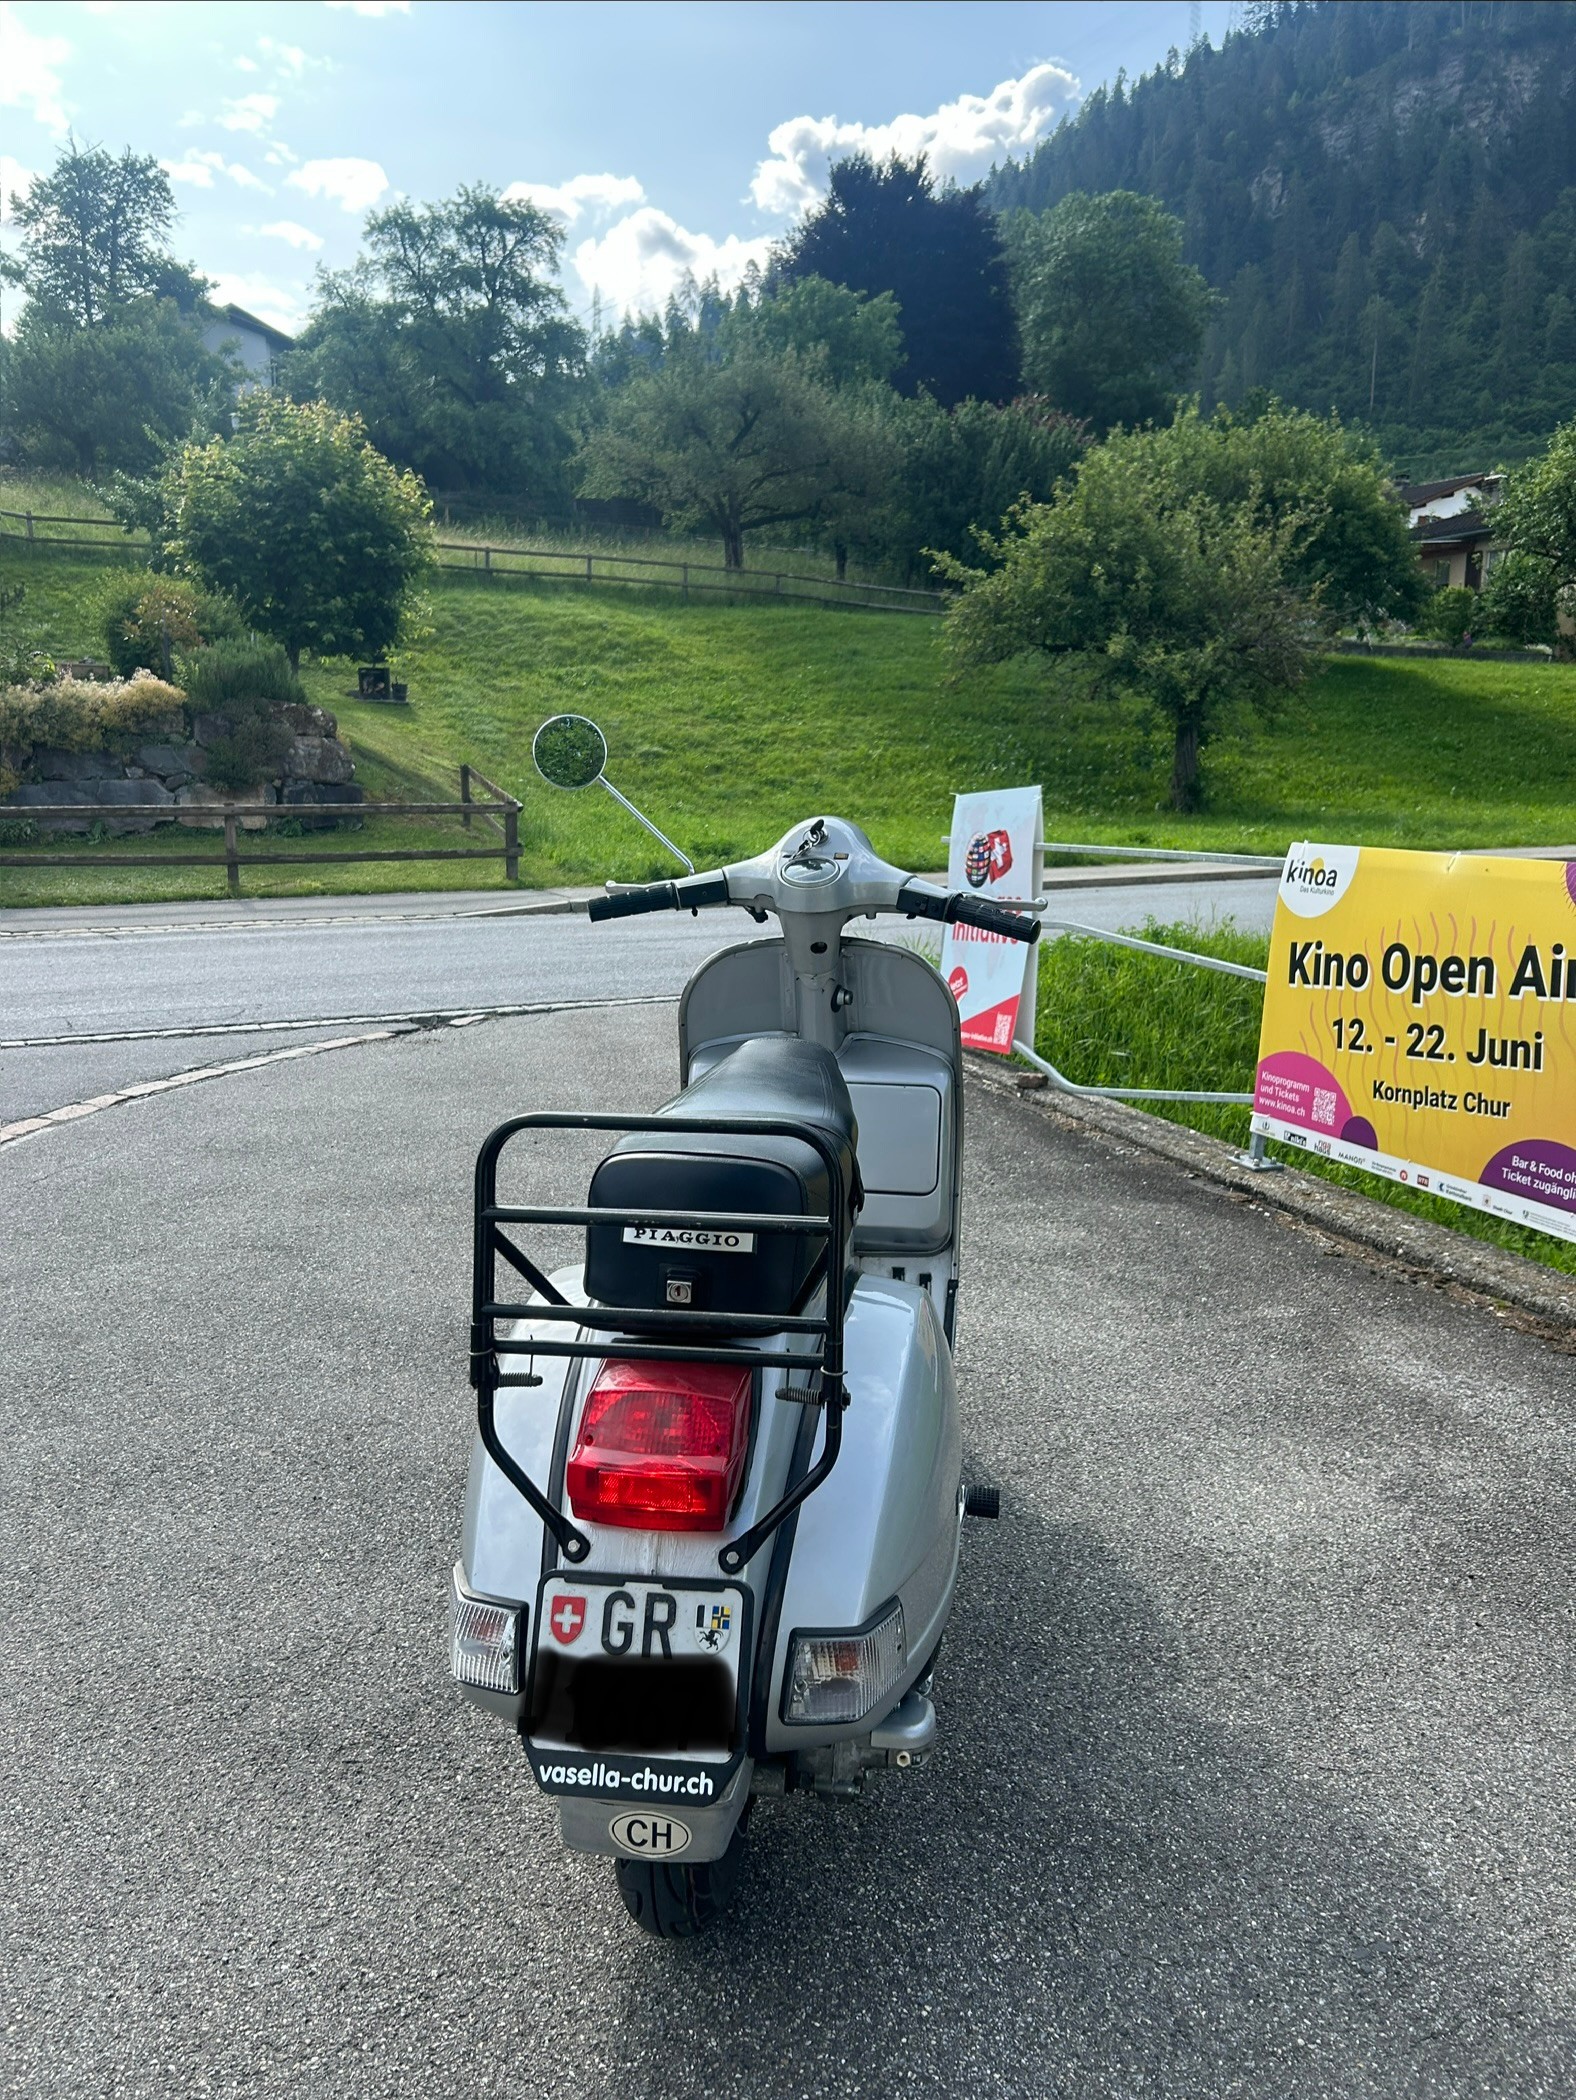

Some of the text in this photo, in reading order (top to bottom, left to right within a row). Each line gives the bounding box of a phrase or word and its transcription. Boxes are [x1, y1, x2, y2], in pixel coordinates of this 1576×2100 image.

[1286, 859, 1338, 887] kinoa
[1300, 885, 1334, 896] Das Kulturkino
[1288, 940, 1370, 989] Kino
[1381, 942, 1496, 1007] Open
[1332, 1018, 1544, 1072] 12. - 22. Juni
[1260, 1084, 1300, 1103] und Tickets
[1261, 1070, 1310, 1093] Kinoprogramm
[1258, 1096, 1306, 1117] www.kinoa.ch
[1372, 1080, 1511, 1118] Kornplatz Chur
[1502, 1167, 1531, 1186] Ticket
[1511, 1155, 1529, 1169] Bar
[1529, 1160, 1537, 1172] &
[1538, 1163, 1563, 1180] Food
[633, 1227, 740, 1247] PIAGGIO
[601, 1590, 677, 1660] GR
[539, 1763, 714, 1796] vasella-chur.ch
[626, 1819, 673, 1850] CH
